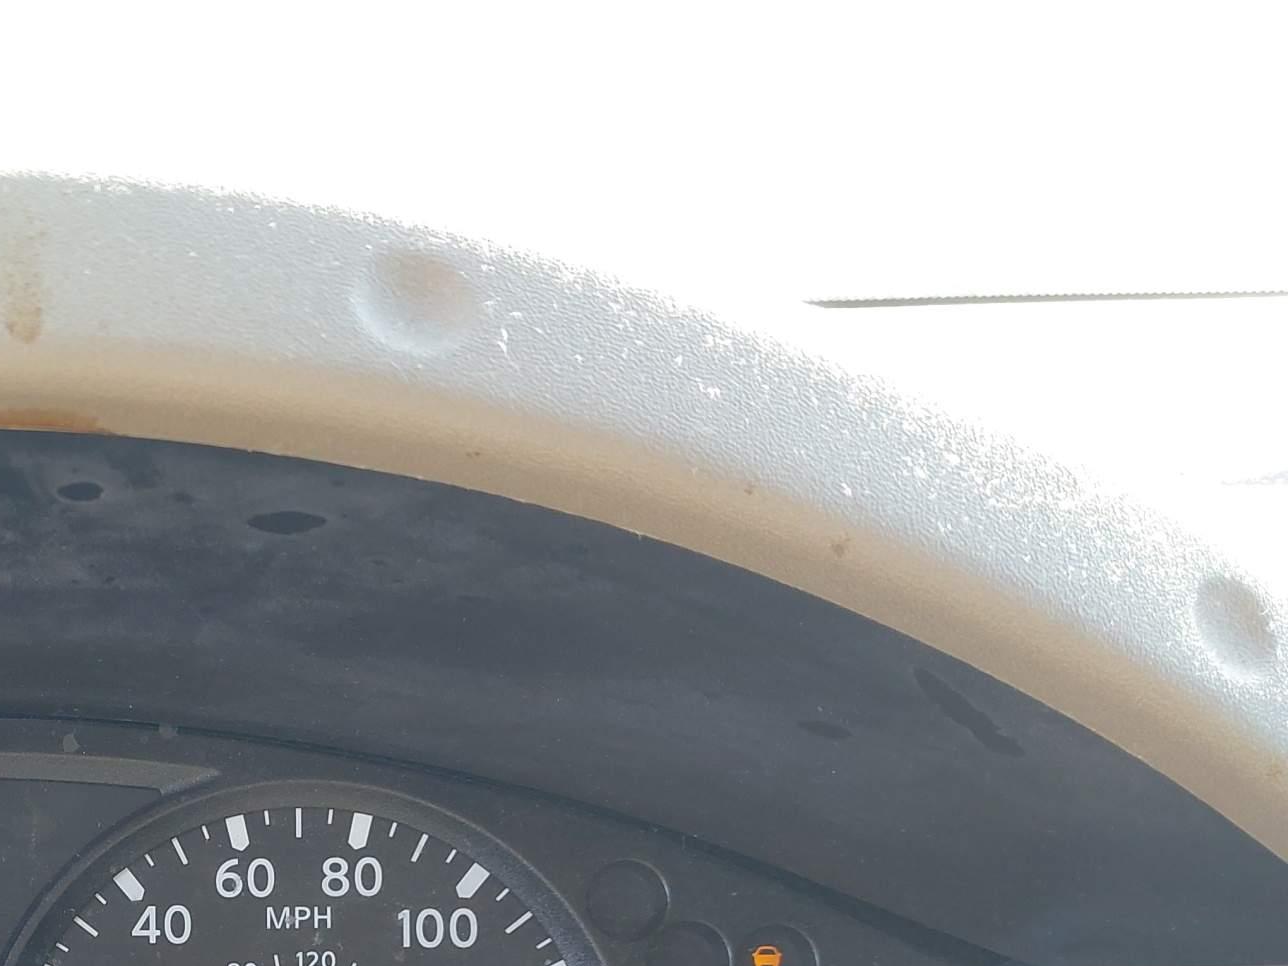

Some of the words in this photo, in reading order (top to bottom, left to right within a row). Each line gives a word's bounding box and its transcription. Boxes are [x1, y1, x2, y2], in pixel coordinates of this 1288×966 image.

[214, 858, 275, 898] 60
[320, 857, 383, 897] 80
[131, 904, 192, 945] 40
[265, 906, 332, 930] MPH
[397, 908, 479, 949] 100
